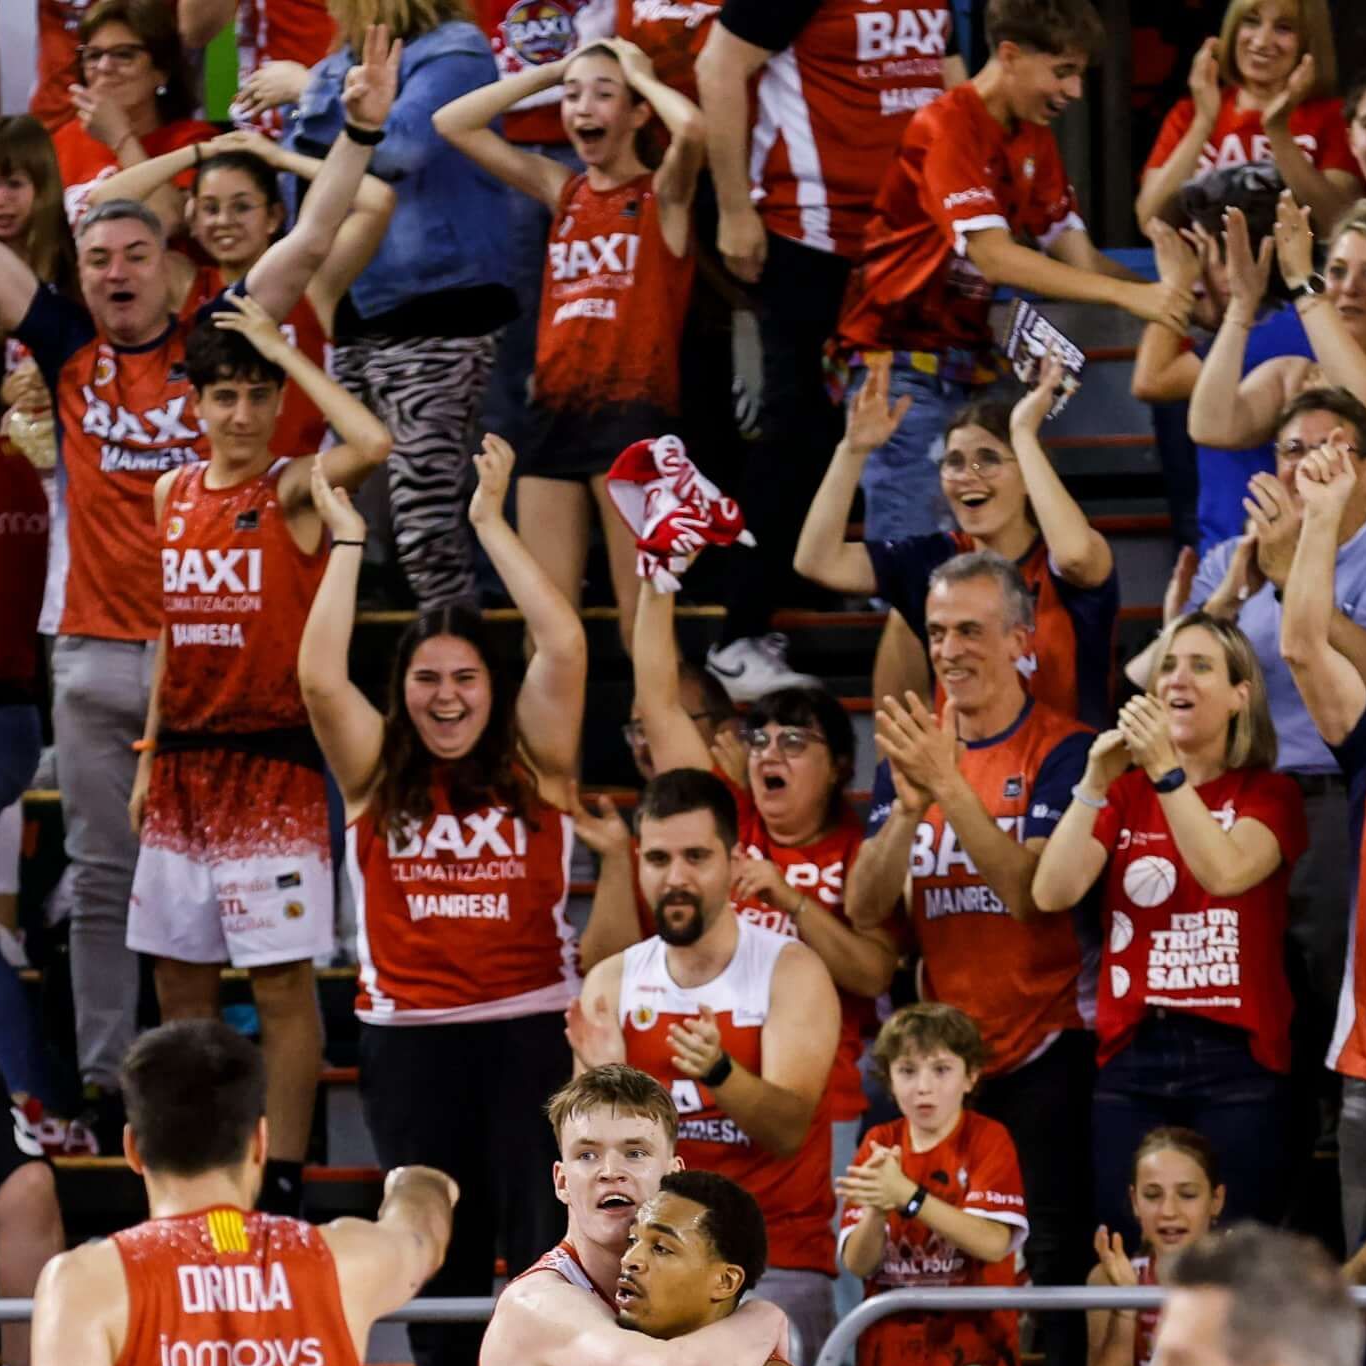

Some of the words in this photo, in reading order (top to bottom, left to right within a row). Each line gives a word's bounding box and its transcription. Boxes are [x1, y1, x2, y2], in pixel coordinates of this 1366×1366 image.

[162, 548, 263, 594] BAXI
[406, 892, 510, 922] MANRESA
[924, 884, 1012, 920] MANRES
[1206, 908, 1239, 928] UN
[1150, 926, 1240, 951] TRIPLE
[1148, 946, 1240, 967] DONANT
[1146, 962, 1240, 990] SANG!
